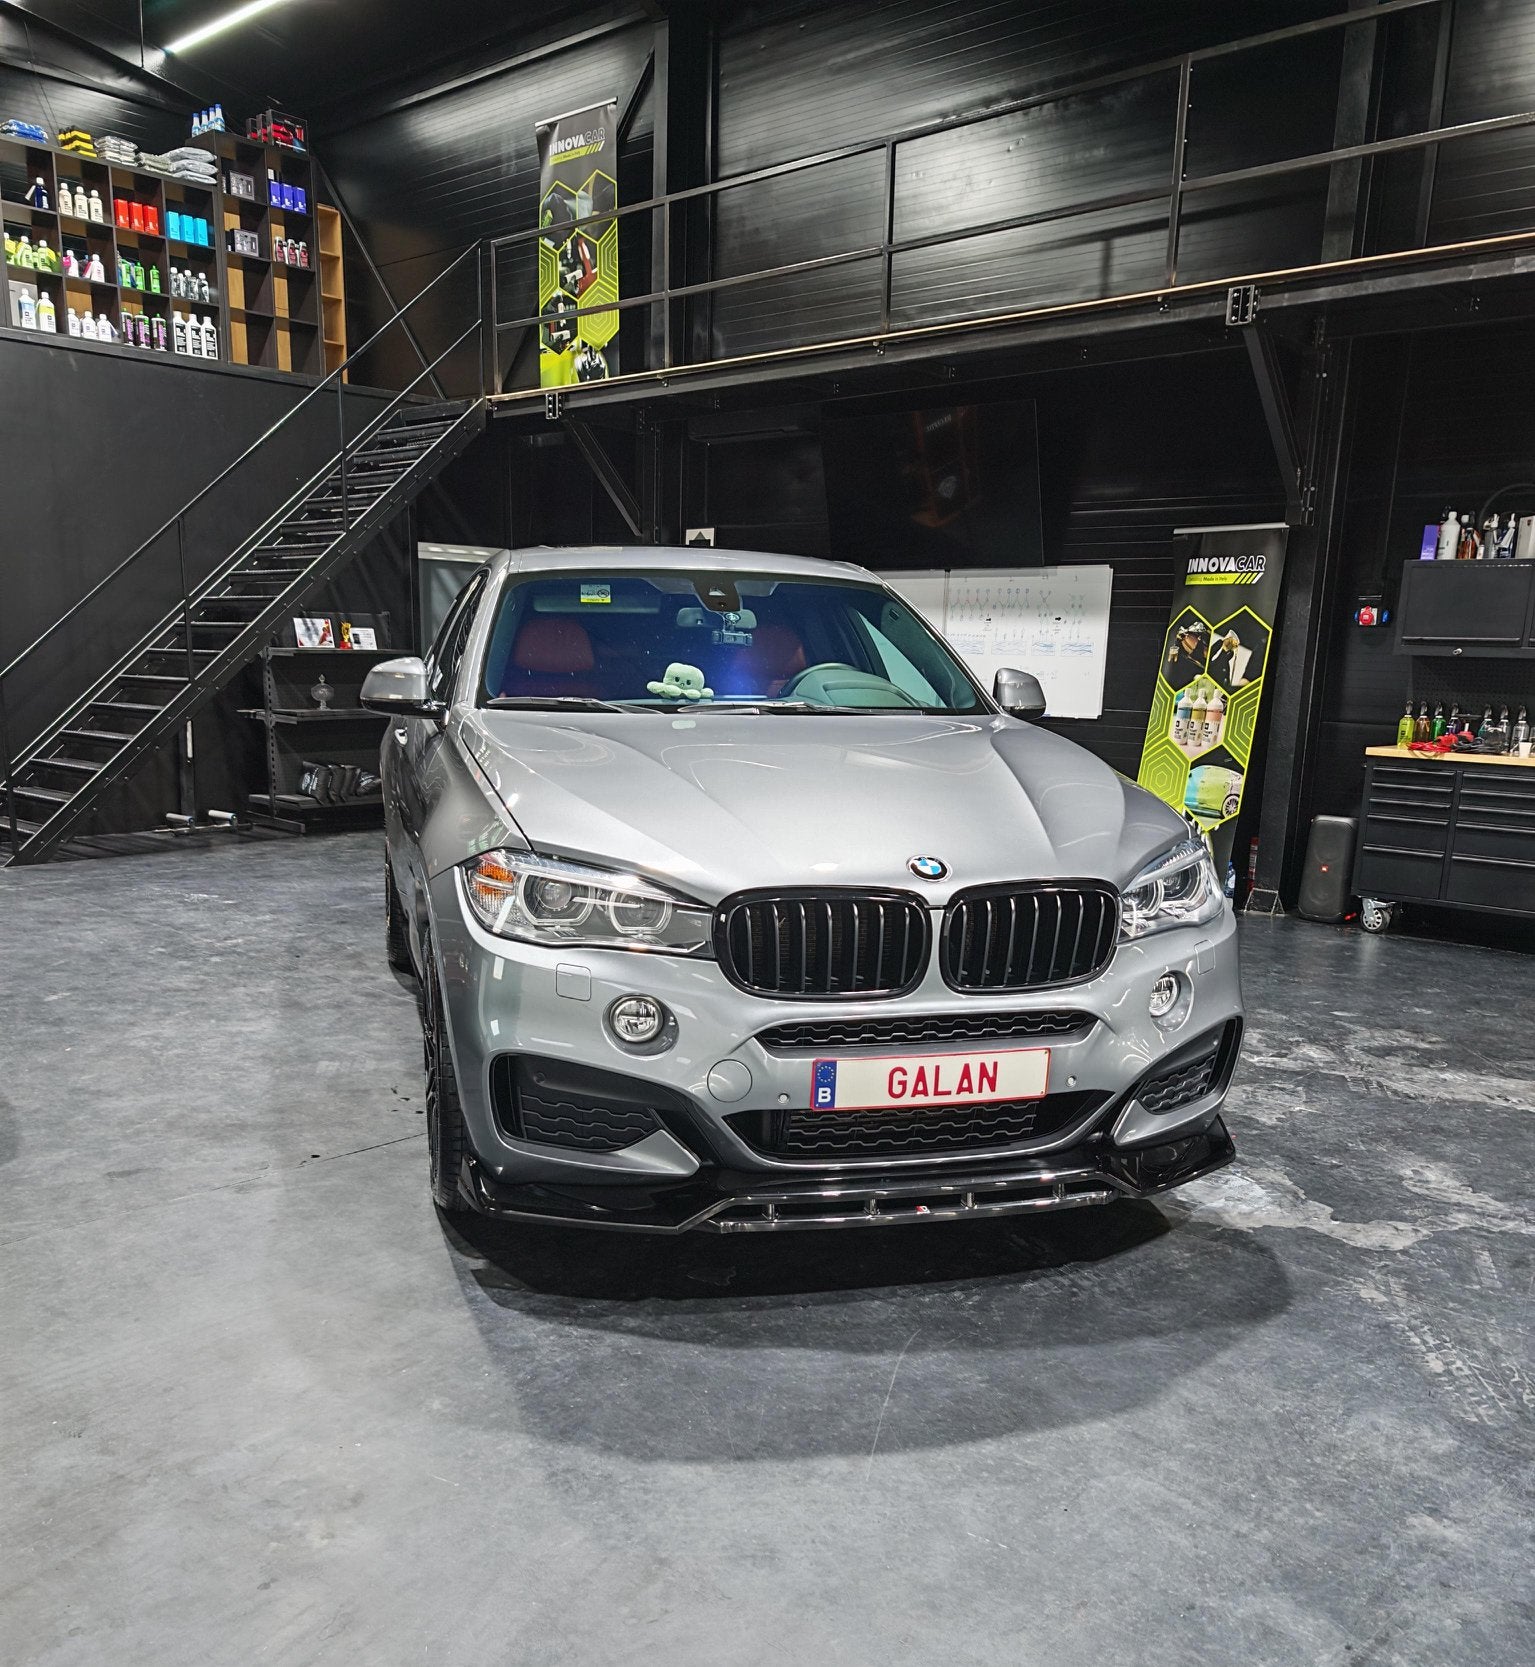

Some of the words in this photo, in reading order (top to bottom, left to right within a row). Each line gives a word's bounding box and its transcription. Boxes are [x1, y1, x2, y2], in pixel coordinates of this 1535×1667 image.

[549, 127, 606, 157] INNOVACAR
[1187, 555, 1266, 573] INNOVACAR
[817, 1087, 832, 1103] B
[887, 1061, 998, 1099] GALAN
